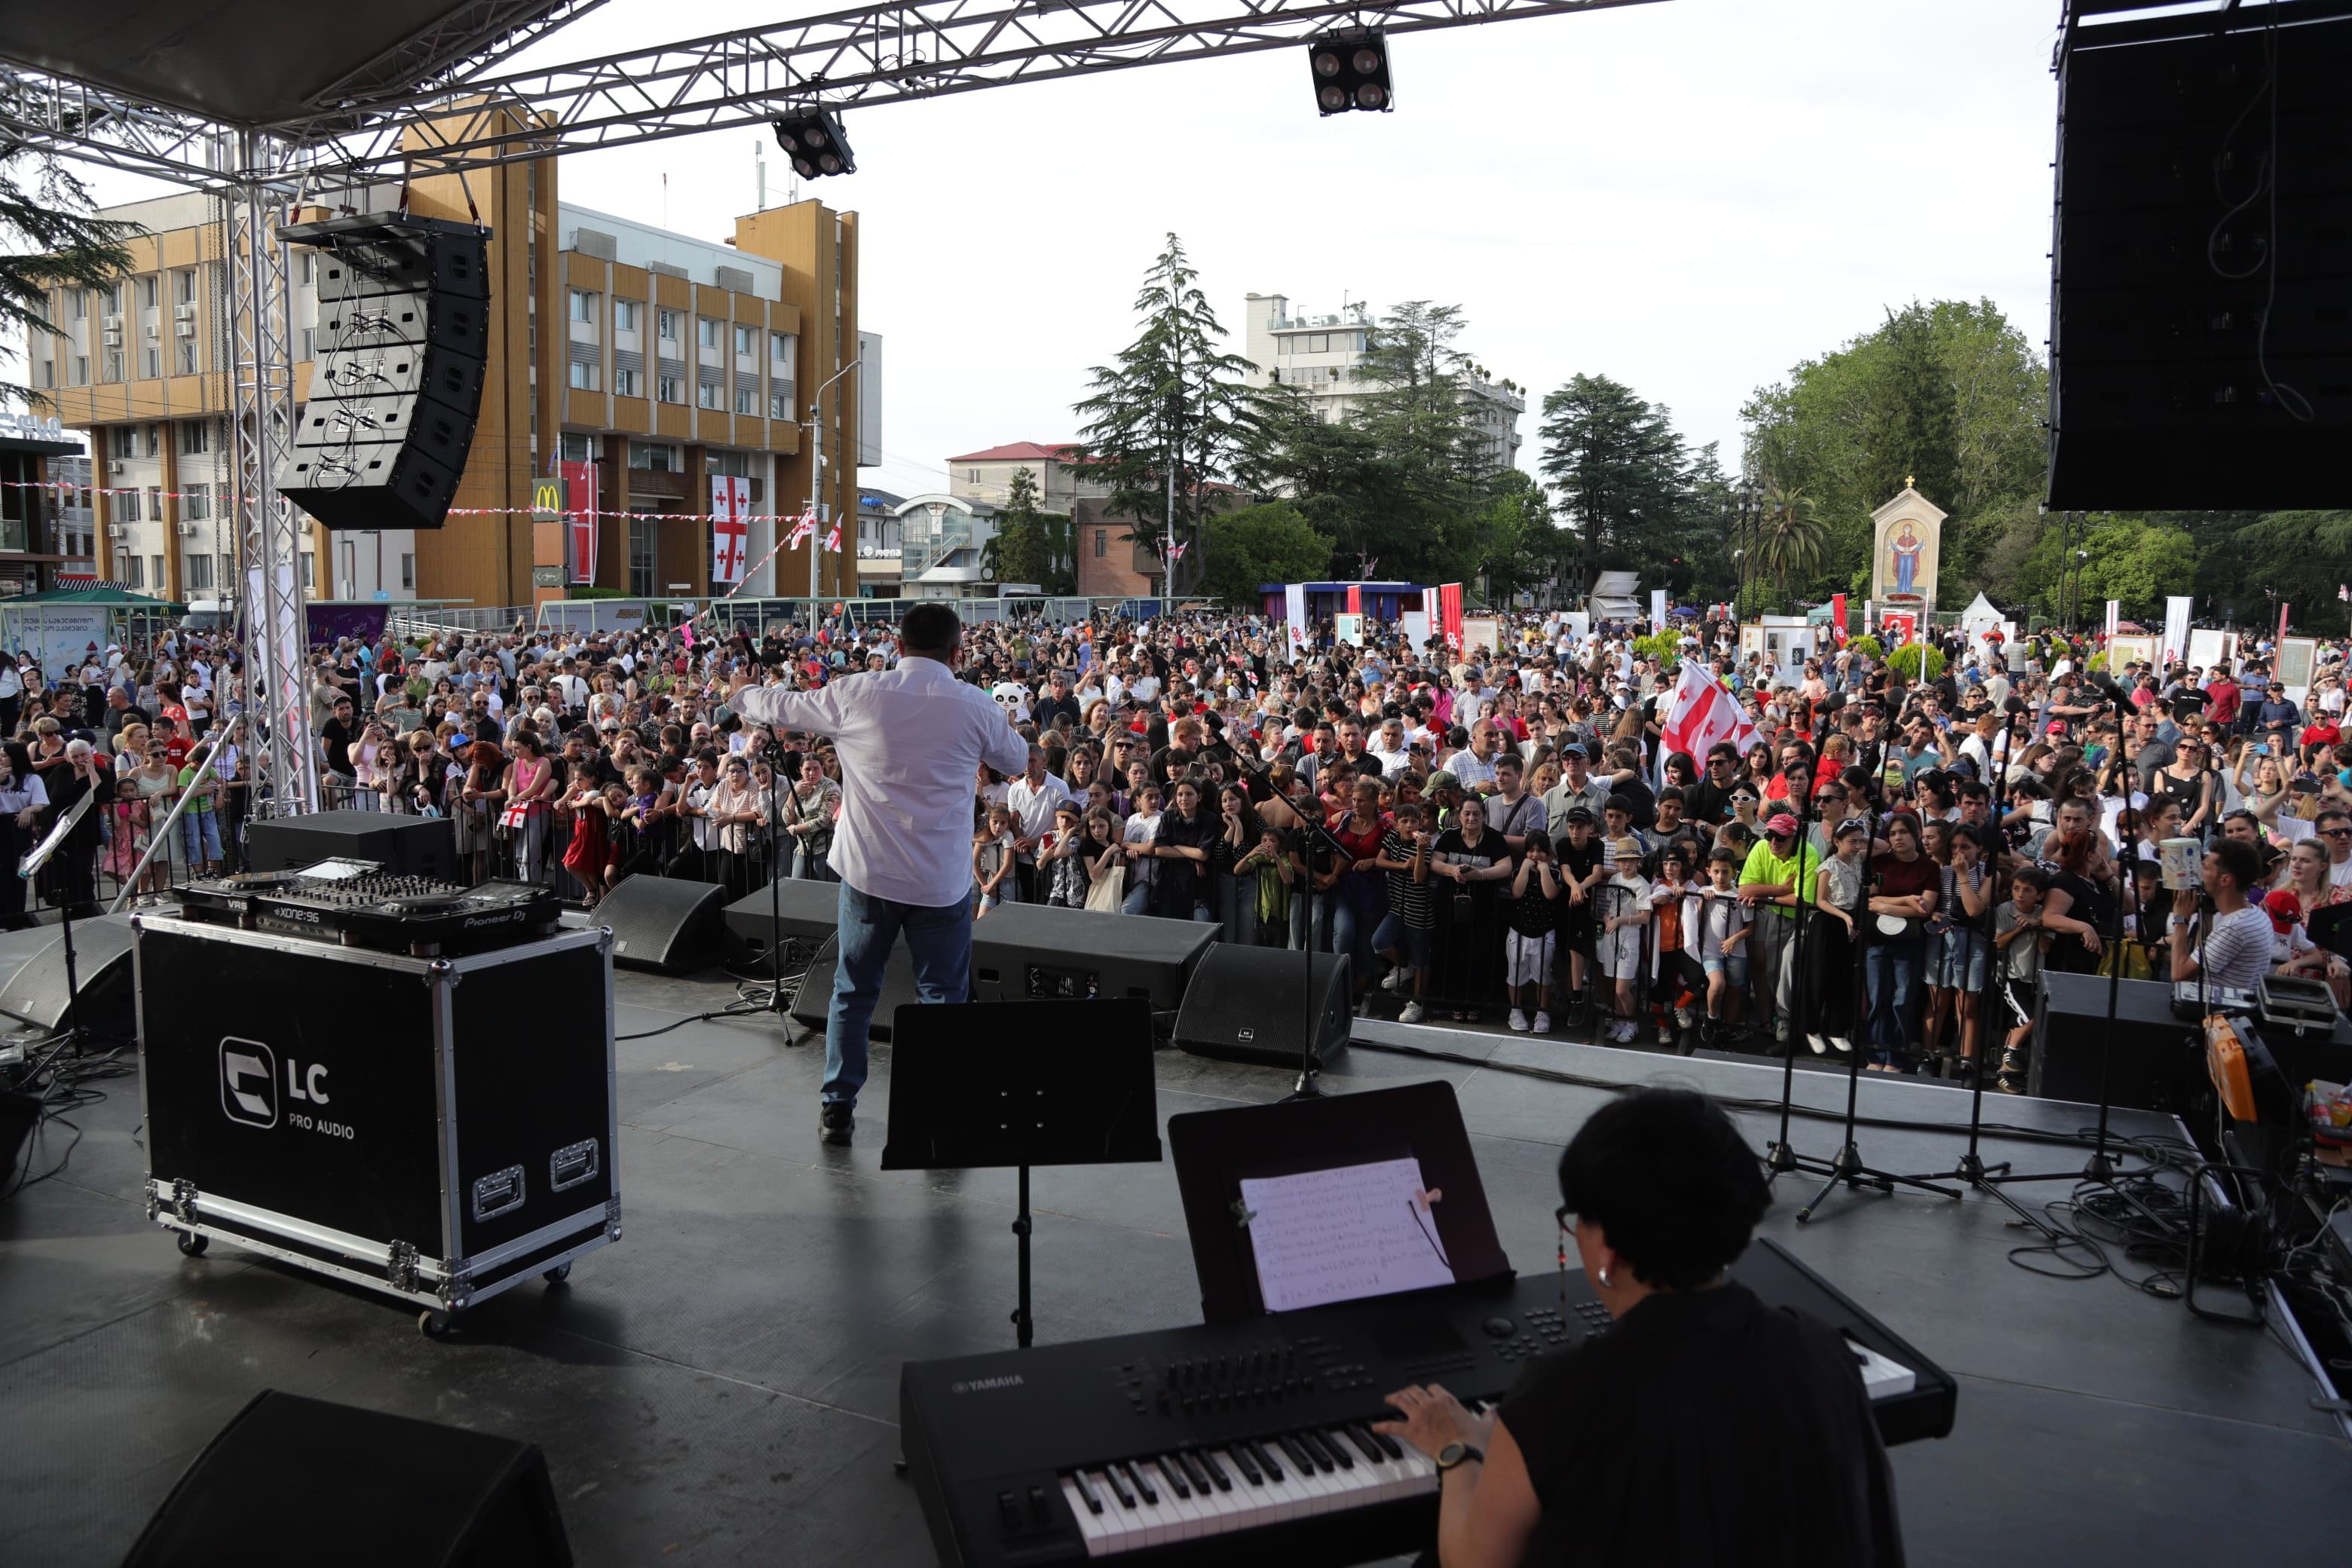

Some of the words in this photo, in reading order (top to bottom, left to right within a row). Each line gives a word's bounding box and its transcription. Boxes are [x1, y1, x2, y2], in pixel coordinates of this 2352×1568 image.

[228, 899, 248, 911] VRS
[464, 914, 512, 929] Pioneer
[287, 1058, 330, 1105] LC
[289, 1113, 313, 1130] PRO
[317, 1119, 355, 1140] AUDIO
[968, 1374, 1024, 1392] YAMAHA
